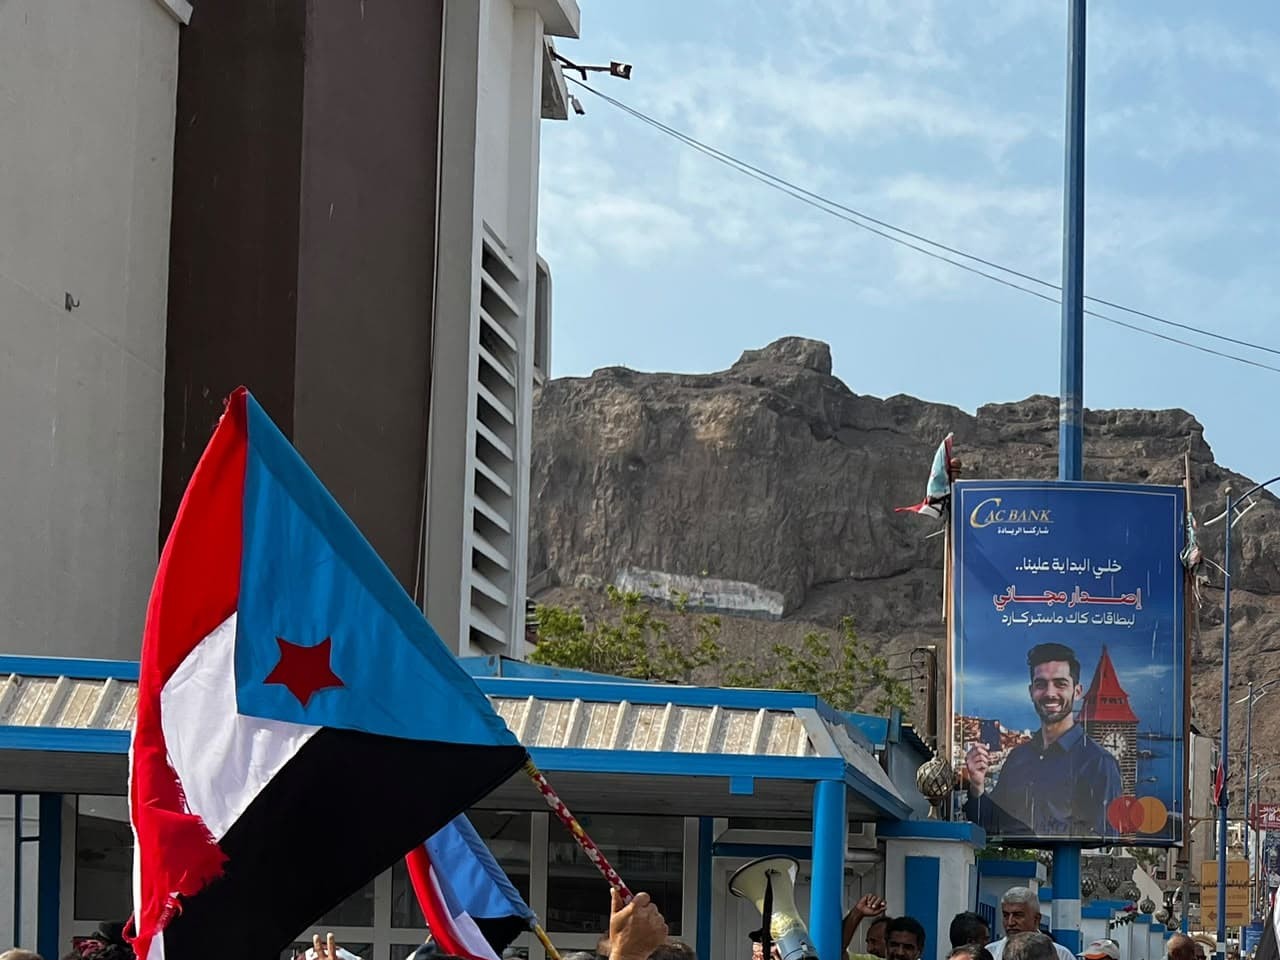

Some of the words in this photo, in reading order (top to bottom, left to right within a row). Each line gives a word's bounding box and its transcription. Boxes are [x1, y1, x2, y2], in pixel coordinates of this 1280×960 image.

[1008, 509, 1052, 522] BANK
[1052, 557, 1090, 575] البداية
[1092, 559, 1122, 579] خلي
[993, 584, 1068, 612] مجاني
[1065, 611, 1091, 625] كاك
[1091, 612, 1136, 628] لبطاقات
